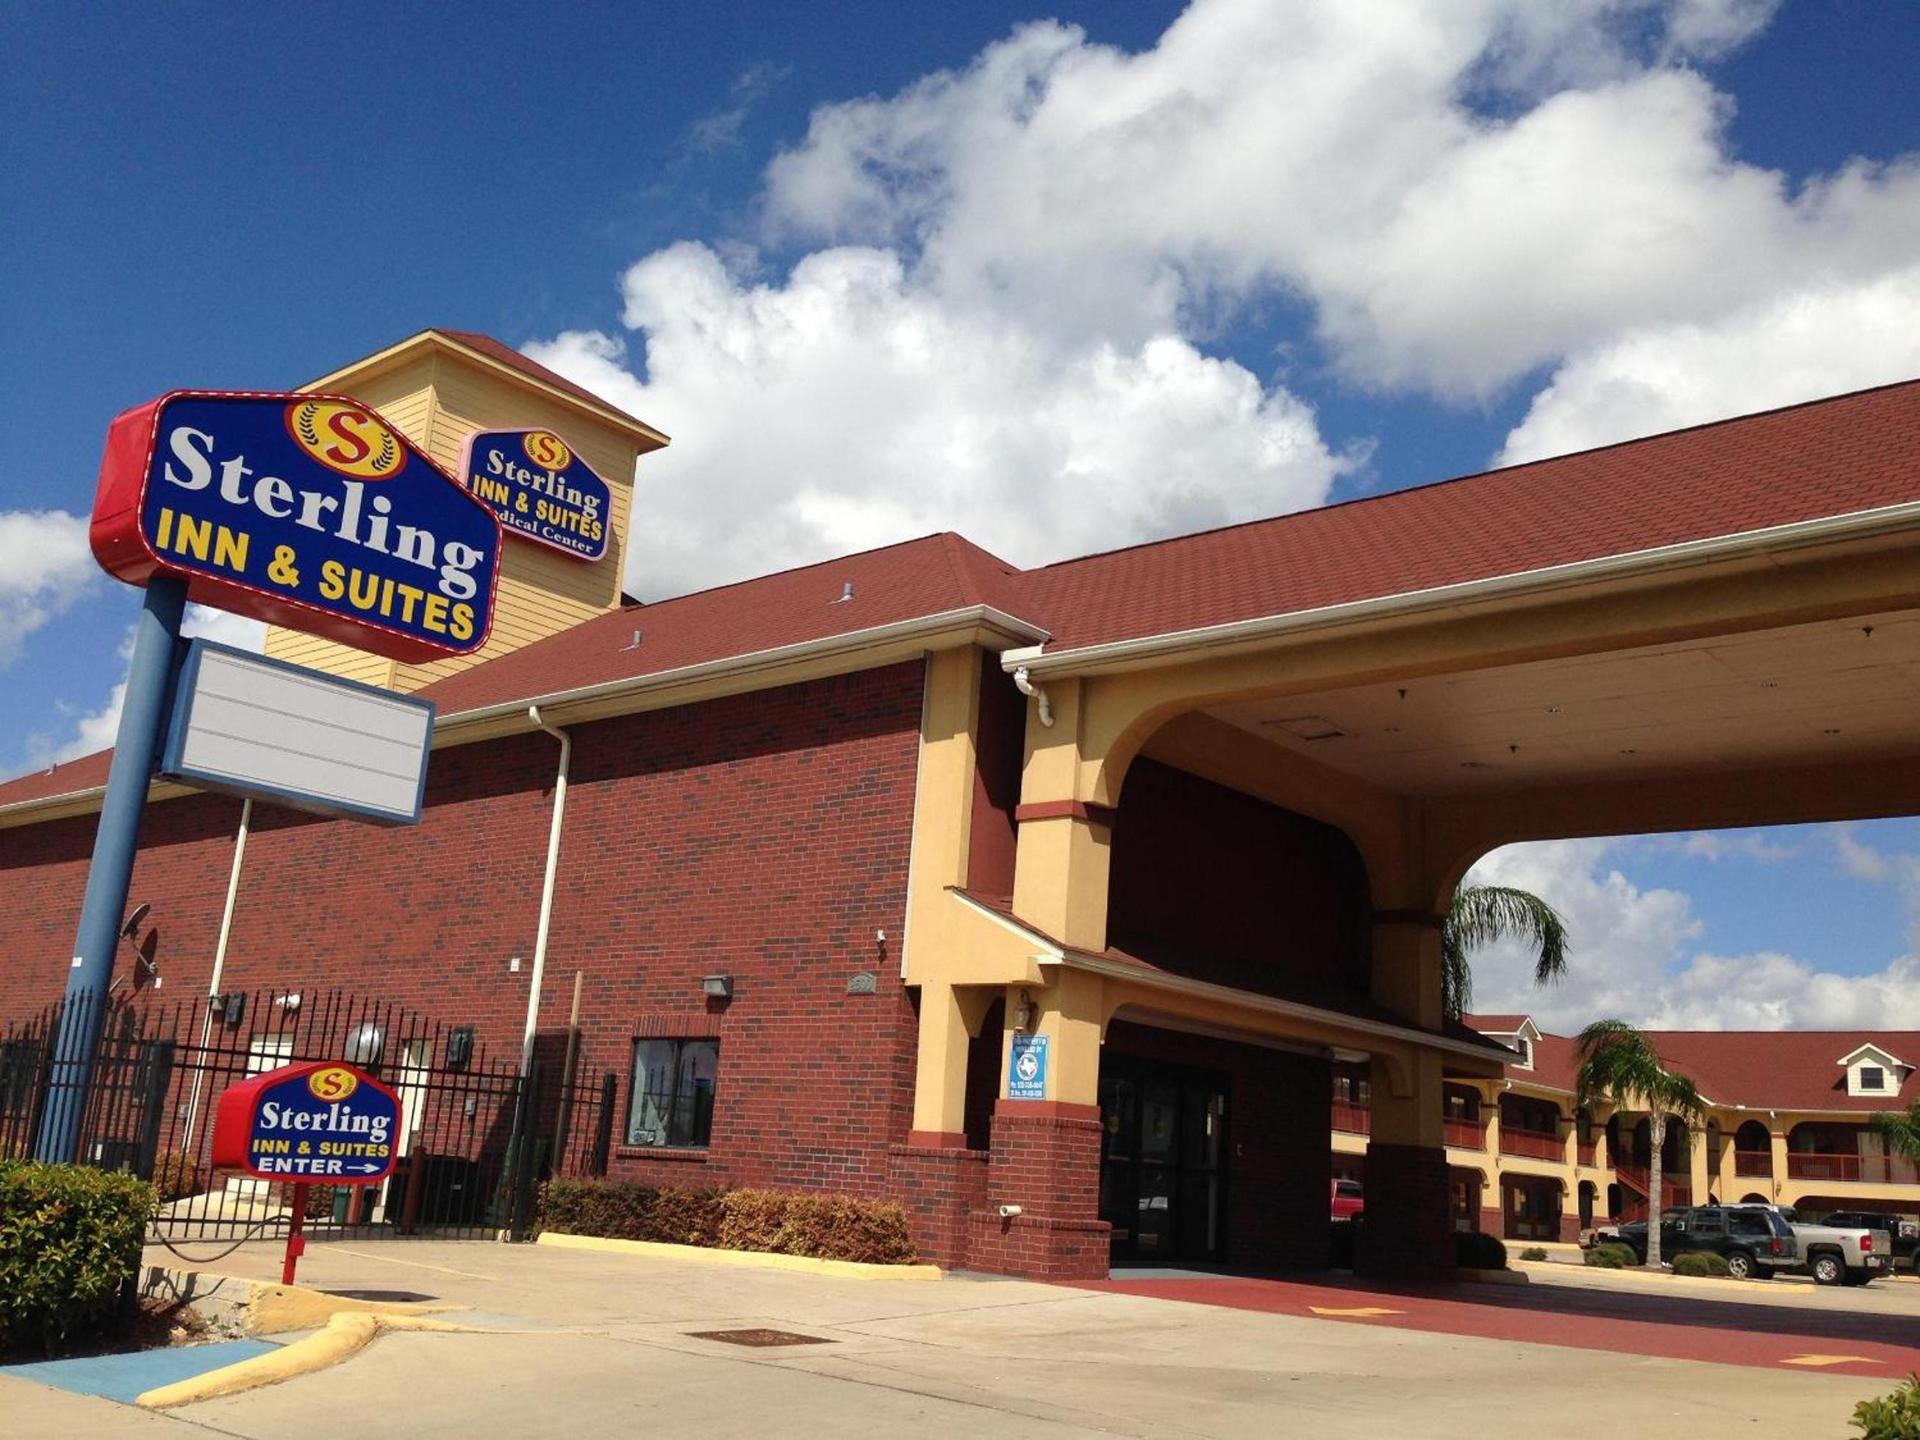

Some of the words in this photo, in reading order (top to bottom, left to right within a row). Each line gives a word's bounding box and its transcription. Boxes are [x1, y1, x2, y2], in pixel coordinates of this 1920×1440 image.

[326, 411, 370, 464] S
[537, 437, 555, 462] S
[487, 449, 600, 520] Sterling
[164, 426, 484, 599] Sterling
[473, 474, 509, 505] INN
[515, 491, 528, 513] &
[536, 499, 603, 541] SUITES
[495, 509, 538, 533] dical
[542, 526, 594, 554] Center
[156, 509, 249, 571] INN
[267, 544, 299, 587] &
[319, 560, 474, 641] SUITES
[322, 1072, 341, 1097] S
[260, 1101, 391, 1143] Sterling
[253, 1139, 290, 1154] INN
[297, 1141, 311, 1154] &
[319, 1141, 390, 1157] SUITES
[258, 1157, 343, 1174] ENTER
